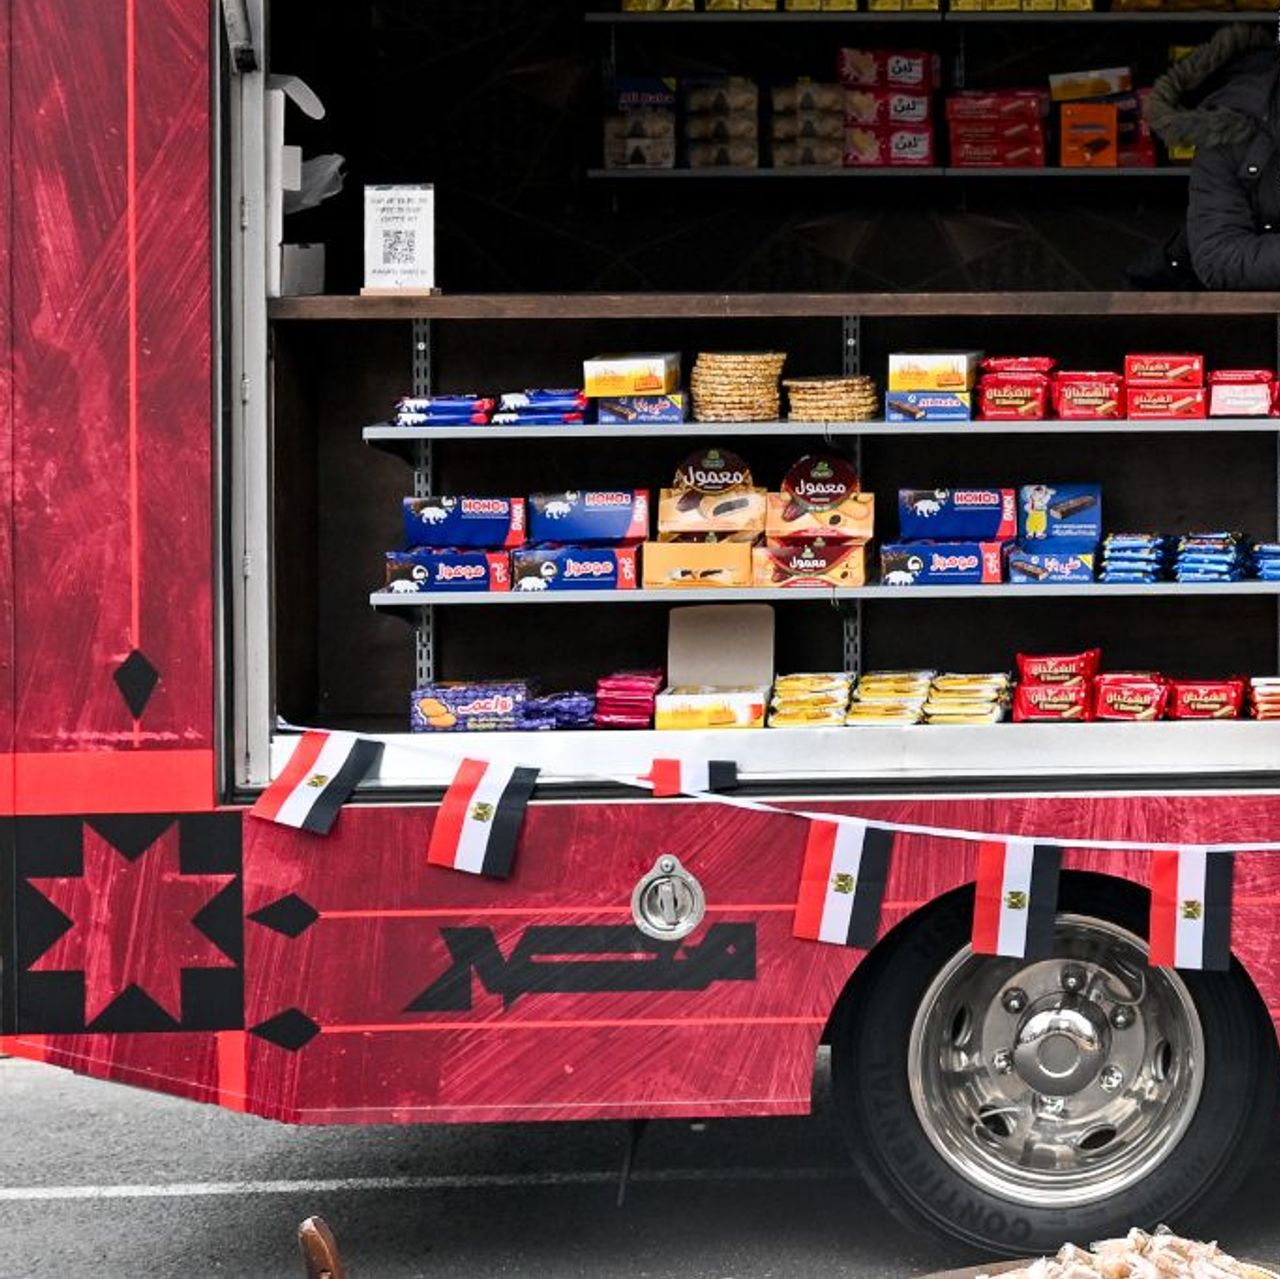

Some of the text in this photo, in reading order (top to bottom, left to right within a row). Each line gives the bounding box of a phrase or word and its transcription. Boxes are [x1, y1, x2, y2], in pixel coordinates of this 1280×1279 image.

[683, 466, 744, 486] معمول
[795, 479, 847, 496] معمول
[789, 556, 828, 570] معمول
